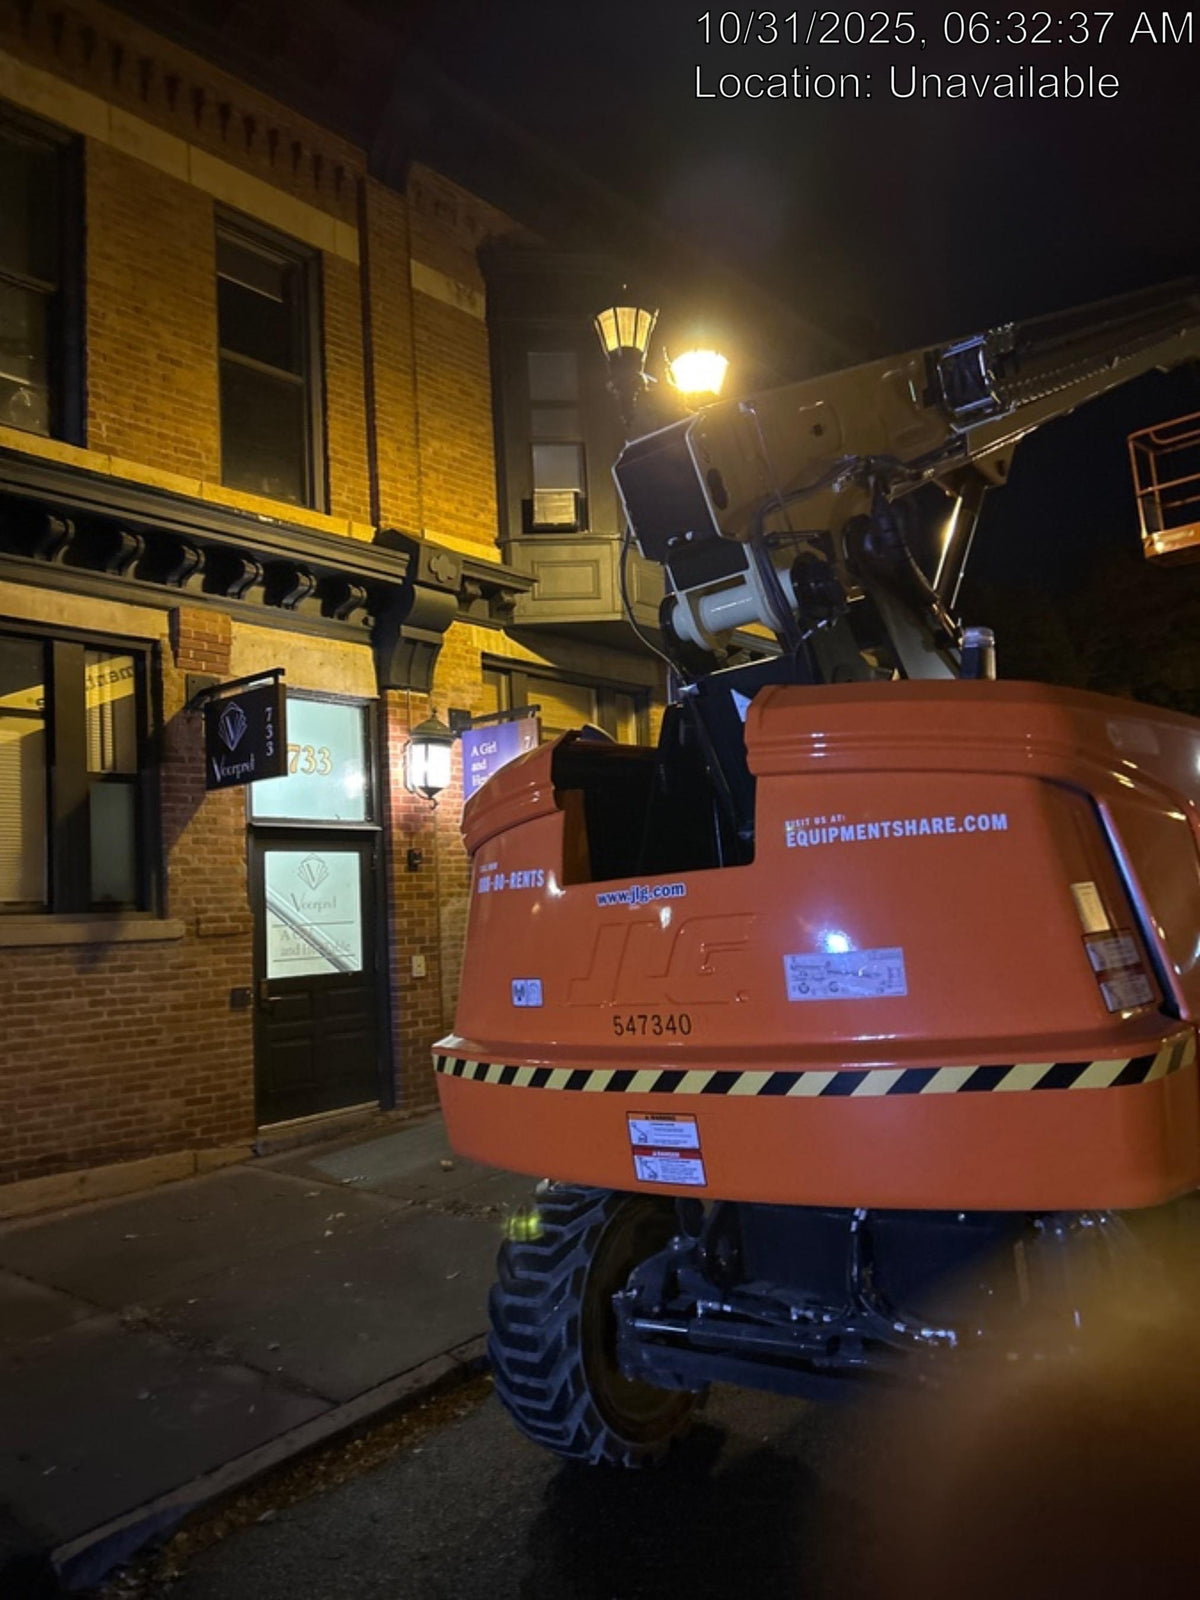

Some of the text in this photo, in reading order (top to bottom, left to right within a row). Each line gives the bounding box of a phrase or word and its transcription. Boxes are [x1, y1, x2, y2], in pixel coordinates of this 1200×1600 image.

[287, 743, 333, 776] 733
[785, 812, 1009, 849] EQUIPMENTSHARE.COM
[596, 883, 685, 906] www.jlg.com
[612, 1012, 692, 1037] 547340
